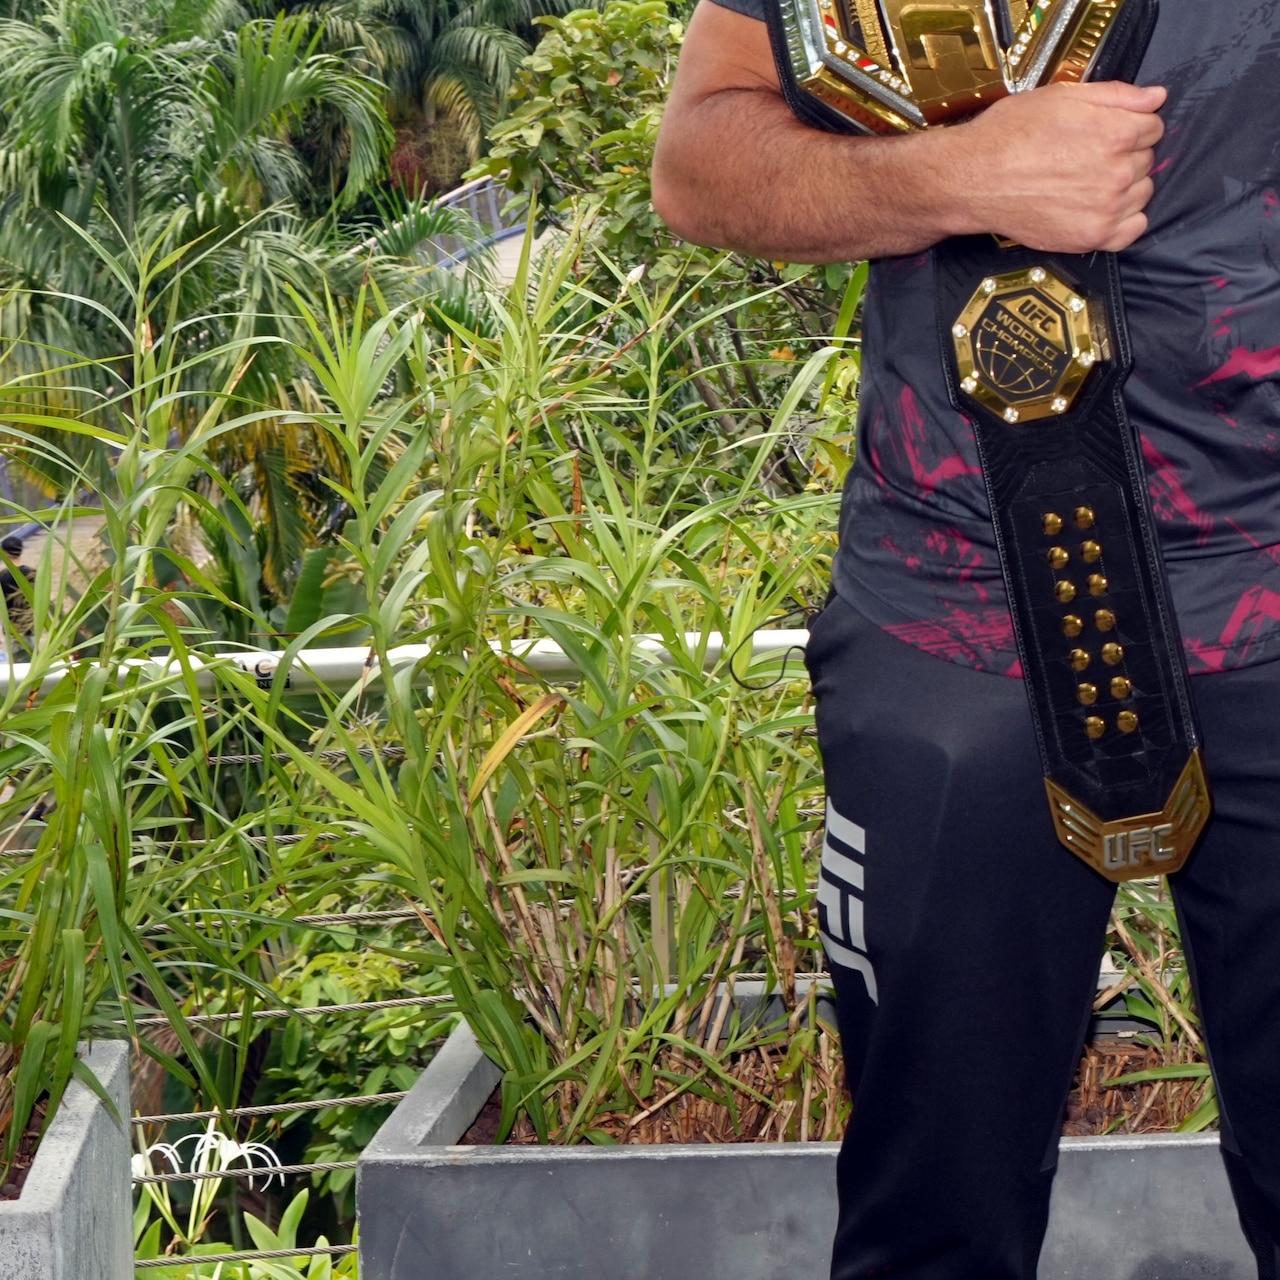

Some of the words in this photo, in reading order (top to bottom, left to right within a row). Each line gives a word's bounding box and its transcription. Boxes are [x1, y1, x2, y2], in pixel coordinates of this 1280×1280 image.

[996, 310, 1059, 361] WORLD
[1018, 299, 1057, 333] UFC
[981, 317, 1059, 378] CHAMPION
[1103, 823, 1174, 870] UFC
[817, 796, 879, 1007] UFC
